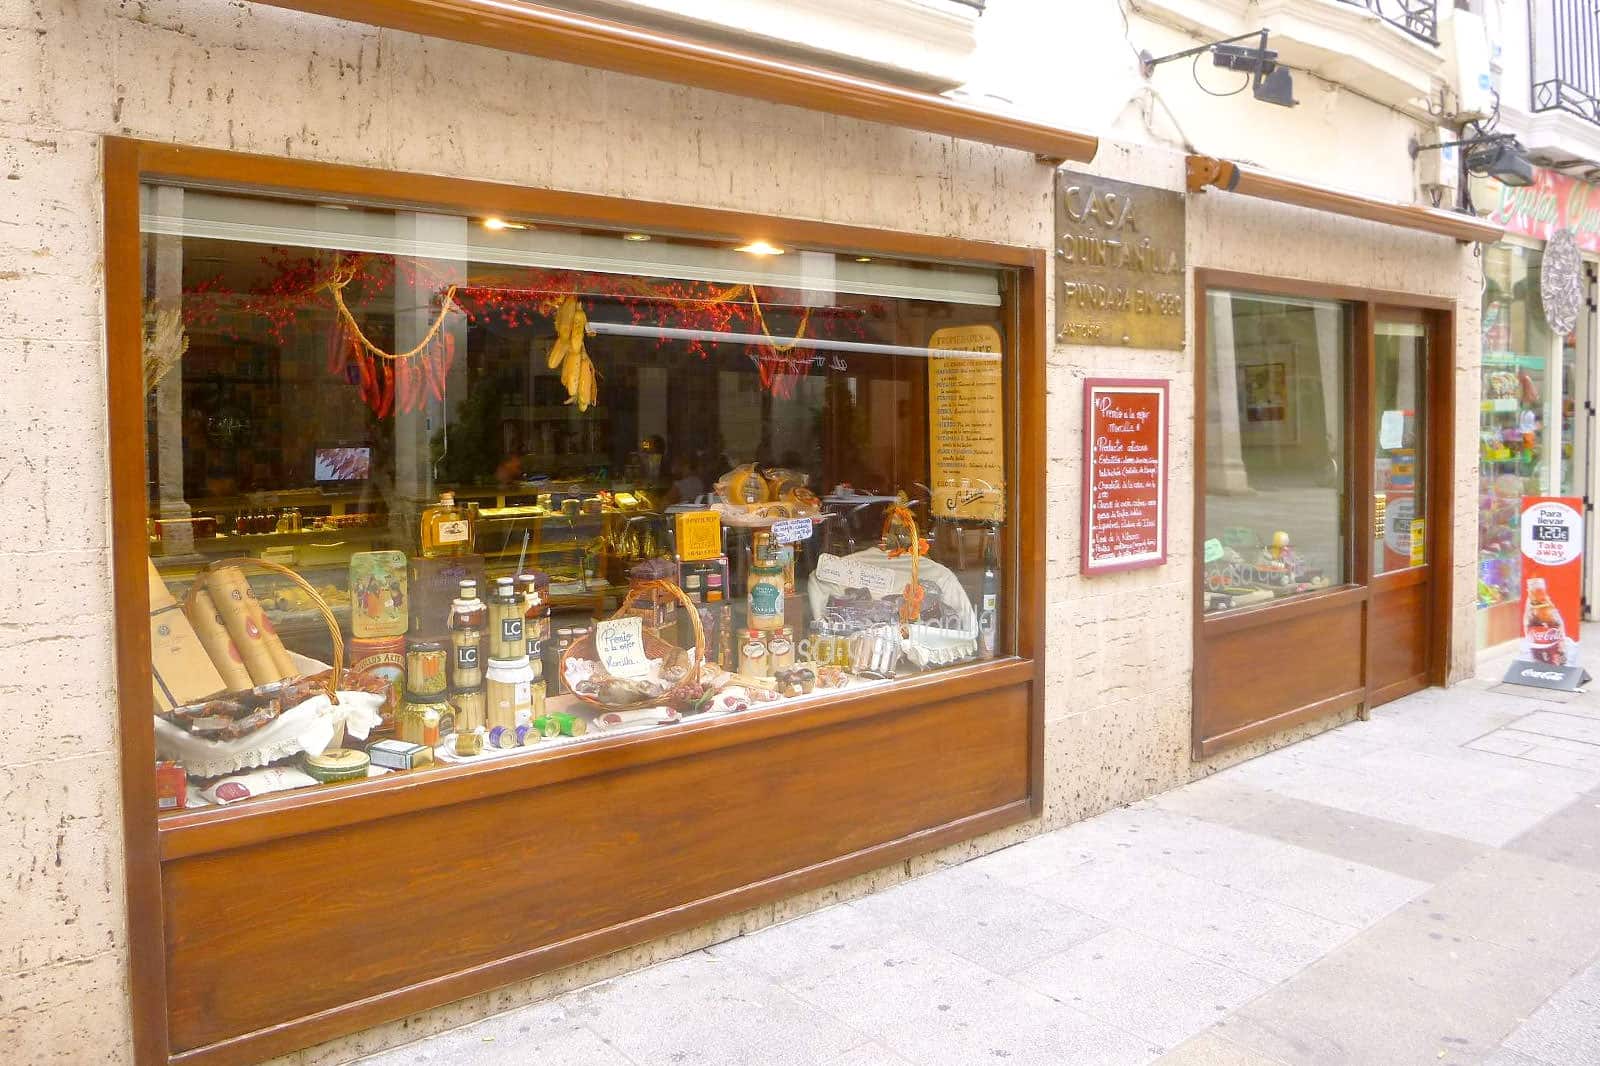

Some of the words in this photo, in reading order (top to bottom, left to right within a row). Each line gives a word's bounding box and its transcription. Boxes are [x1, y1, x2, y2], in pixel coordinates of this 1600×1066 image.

[1064, 185, 1137, 232] CASA
[1540, 509, 1562, 518] Para
[1537, 517, 1564, 525] llevar
[1538, 541, 1564, 549] Take
[1536, 549, 1564, 558] away
[503, 621, 522, 636] LC
[459, 648, 477, 663] LC
